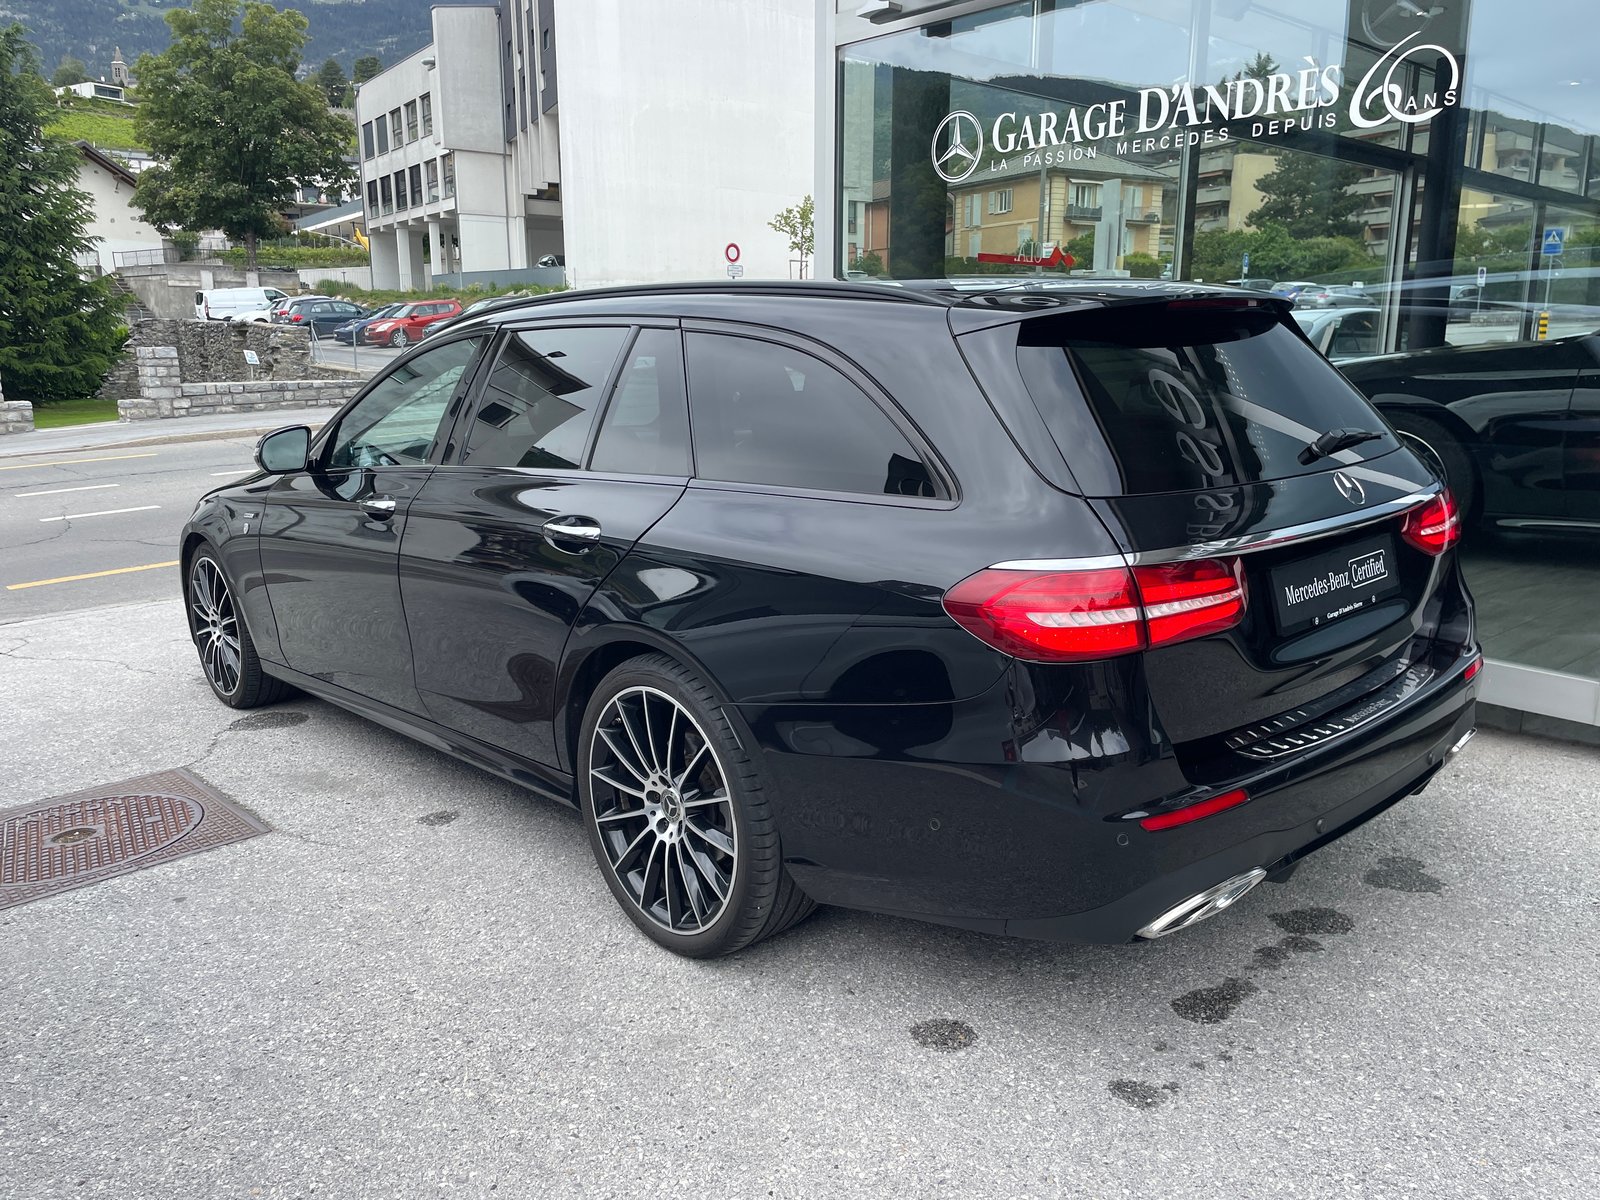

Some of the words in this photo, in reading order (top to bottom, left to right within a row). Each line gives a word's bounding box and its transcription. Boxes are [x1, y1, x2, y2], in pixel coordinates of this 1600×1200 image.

[991, 160, 1008, 172] LA
[1023, 145, 1097, 167] PASSION
[1116, 127, 1229, 155] MERCEDES
[1251, 112, 1337, 138] DEPUIS
[1404, 90, 1457, 112] ANS
[992, 99, 1126, 153] GARAGE
[1135, 55, 1340, 134] D'ANDRÈS
[1284, 571, 1351, 606] Mercedes-Benz
[1351, 555, 1386, 583] Certified
